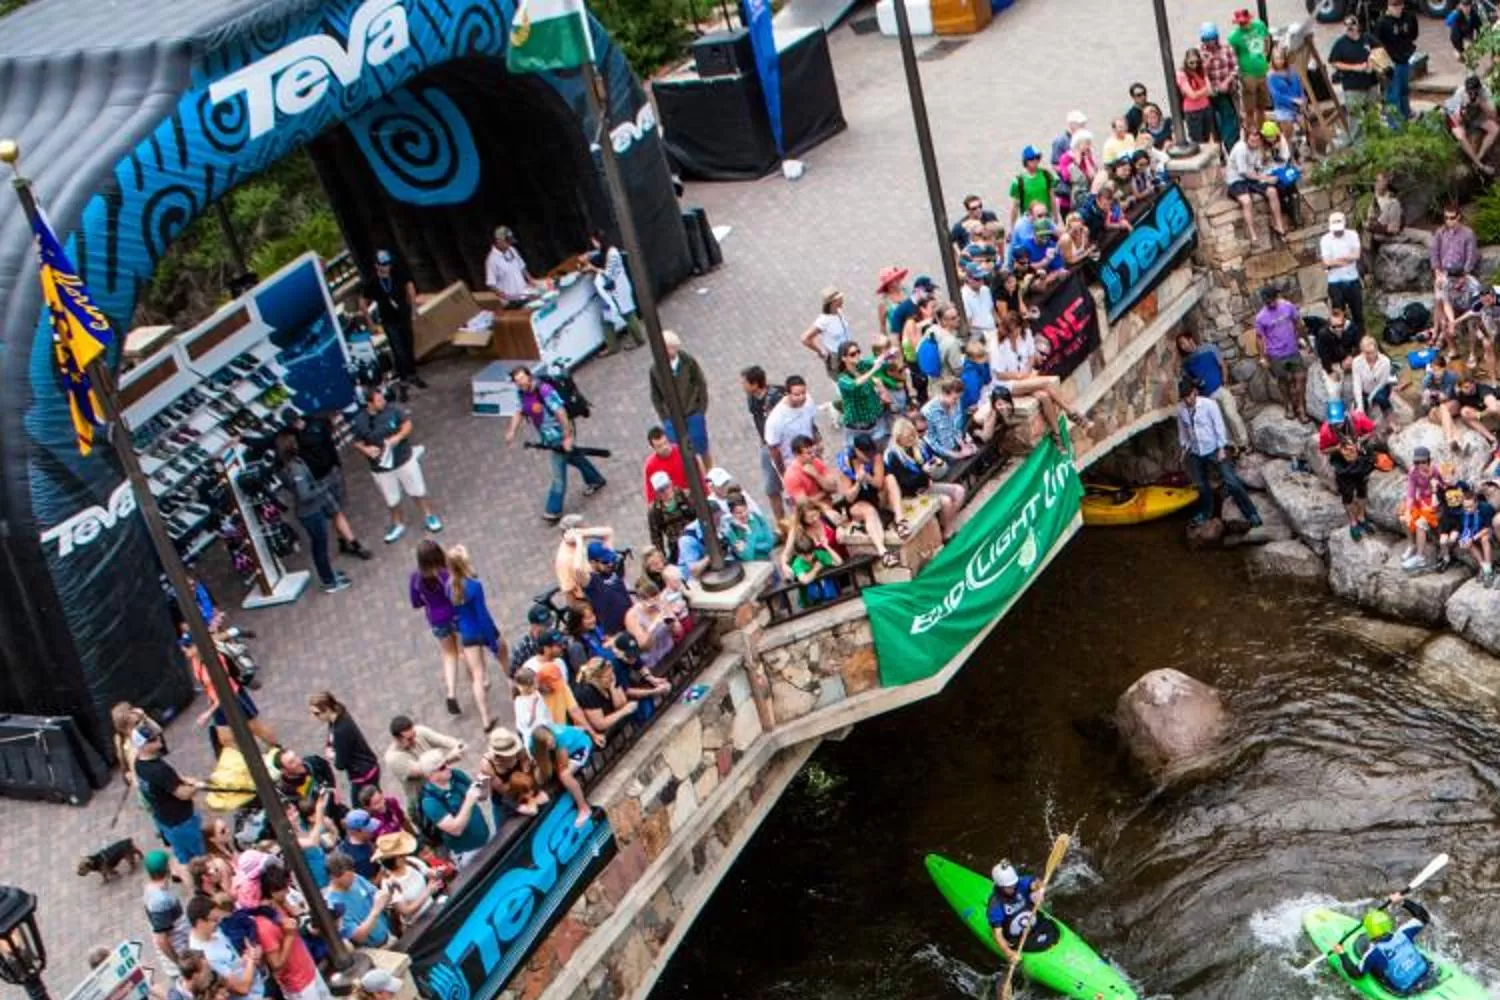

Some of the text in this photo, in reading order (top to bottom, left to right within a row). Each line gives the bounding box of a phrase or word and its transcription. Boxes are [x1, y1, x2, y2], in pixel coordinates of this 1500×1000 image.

[208, 0, 411, 141] Teva
[609, 101, 656, 154] eva
[40, 477, 137, 557] Teva
[444, 790, 595, 978] Teva
